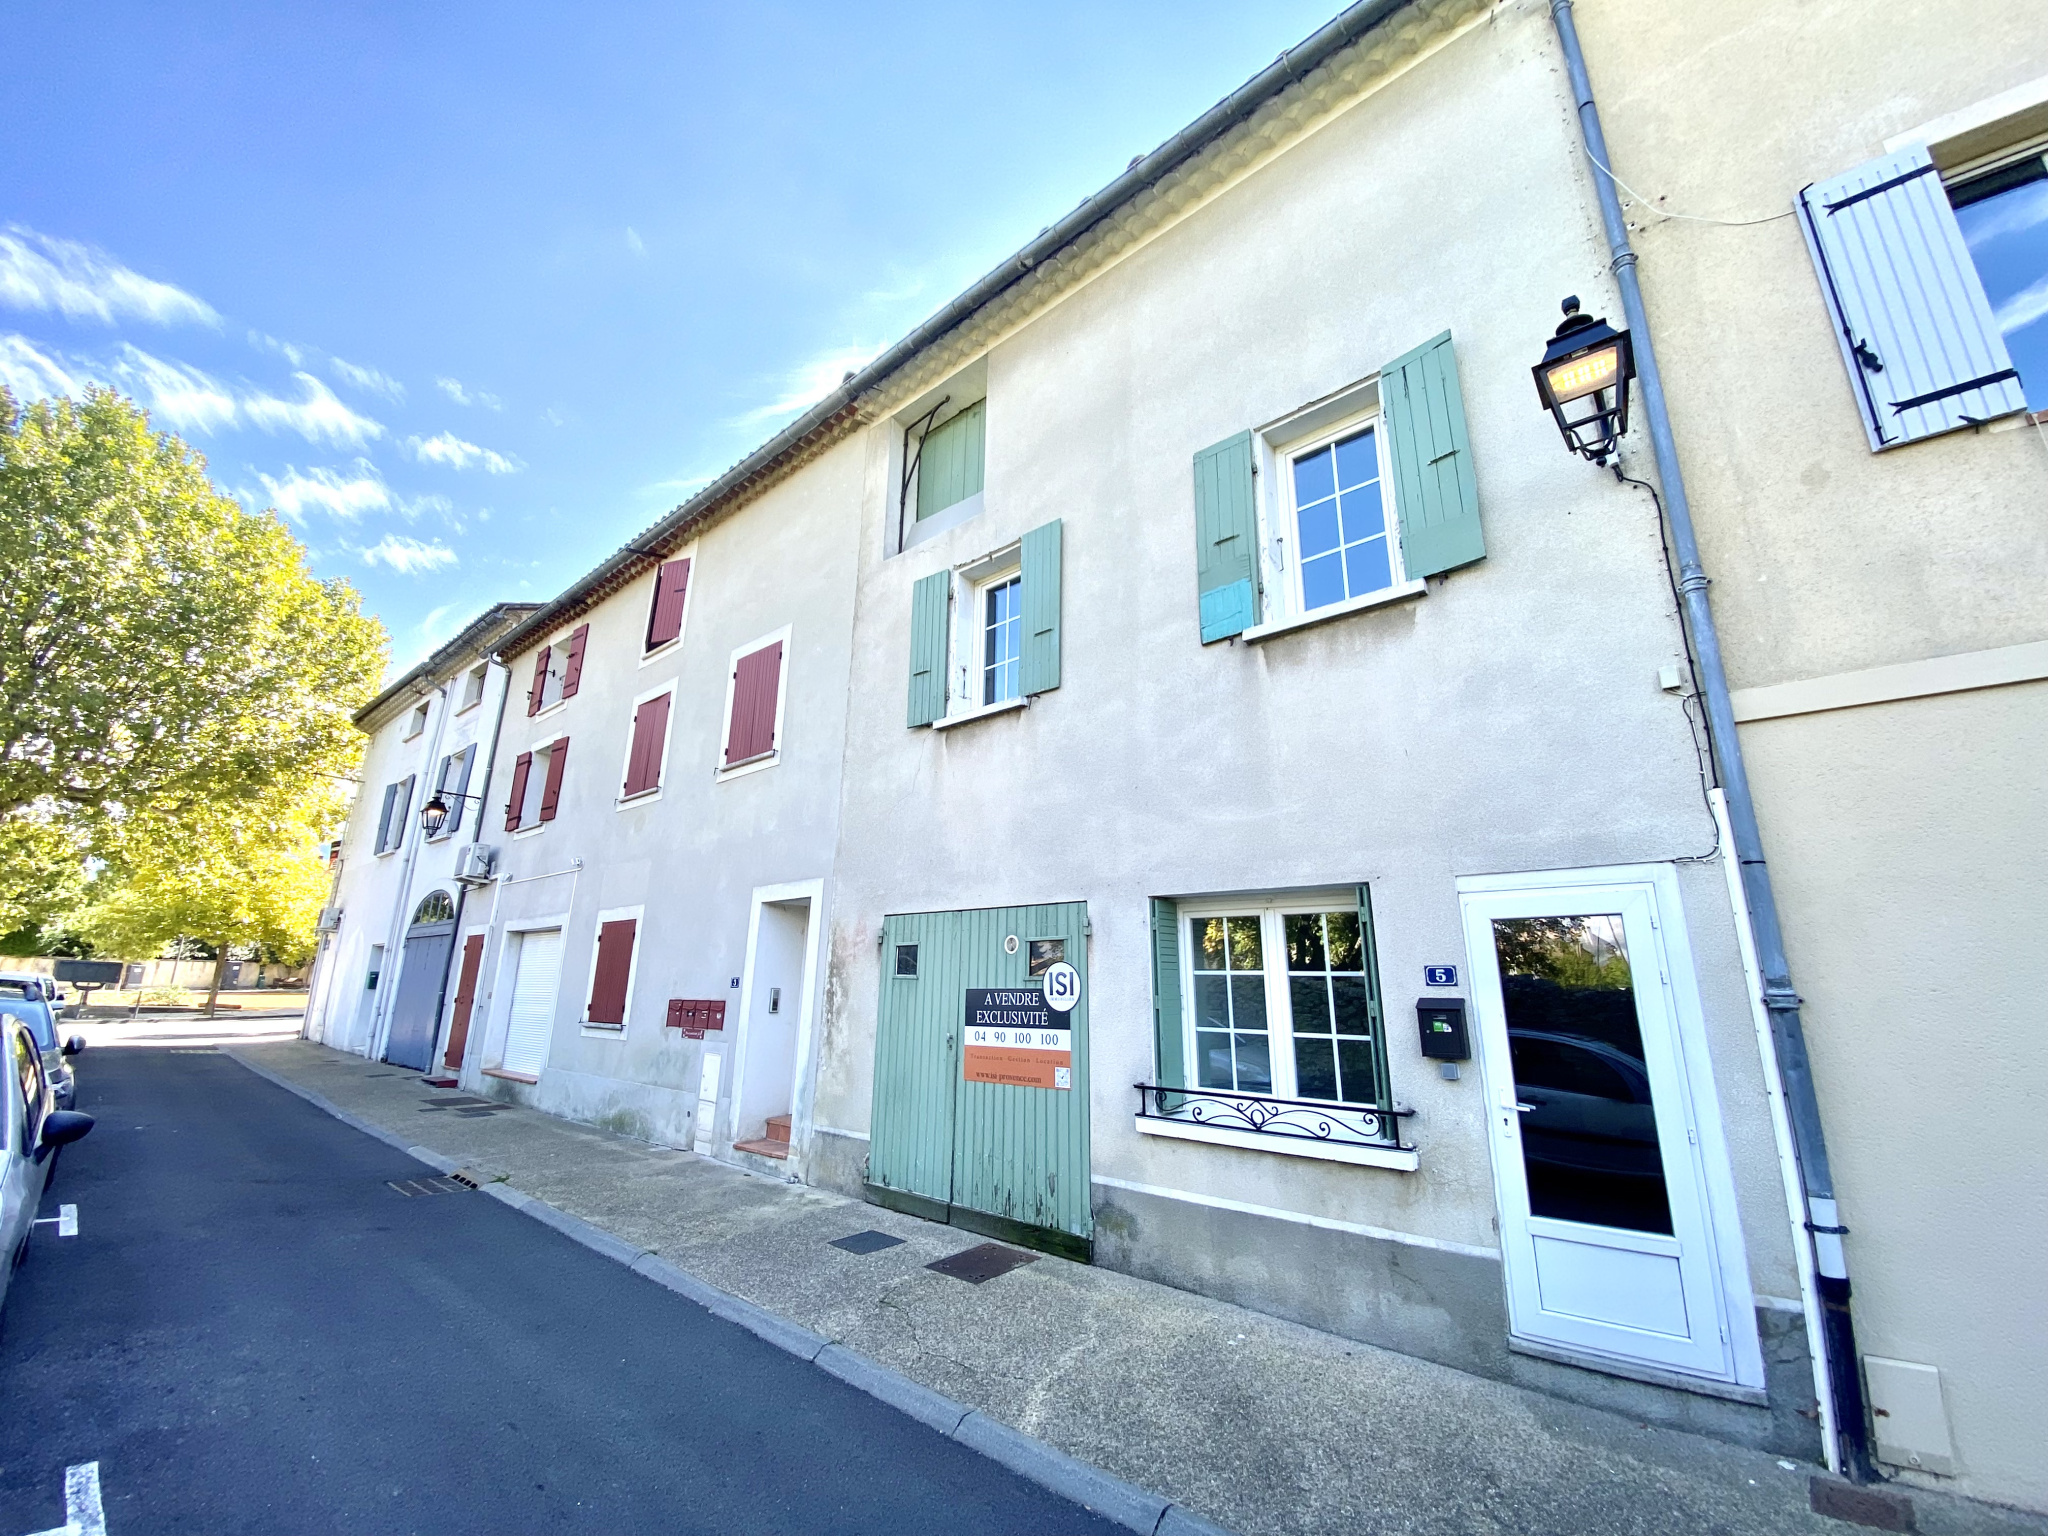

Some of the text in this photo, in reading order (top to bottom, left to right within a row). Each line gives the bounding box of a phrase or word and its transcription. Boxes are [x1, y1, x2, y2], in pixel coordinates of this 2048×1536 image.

[1435, 969, 1447, 982] 5
[1049, 971, 1074, 996] ISI
[984, 992, 1040, 1006] A VENDRE
[976, 1008, 1049, 1026] EXCLUSIVITÉ
[974, 1030, 1059, 1046] 04 90 100 100
[970, 1053, 1064, 1065] Transaction Gestion Location
